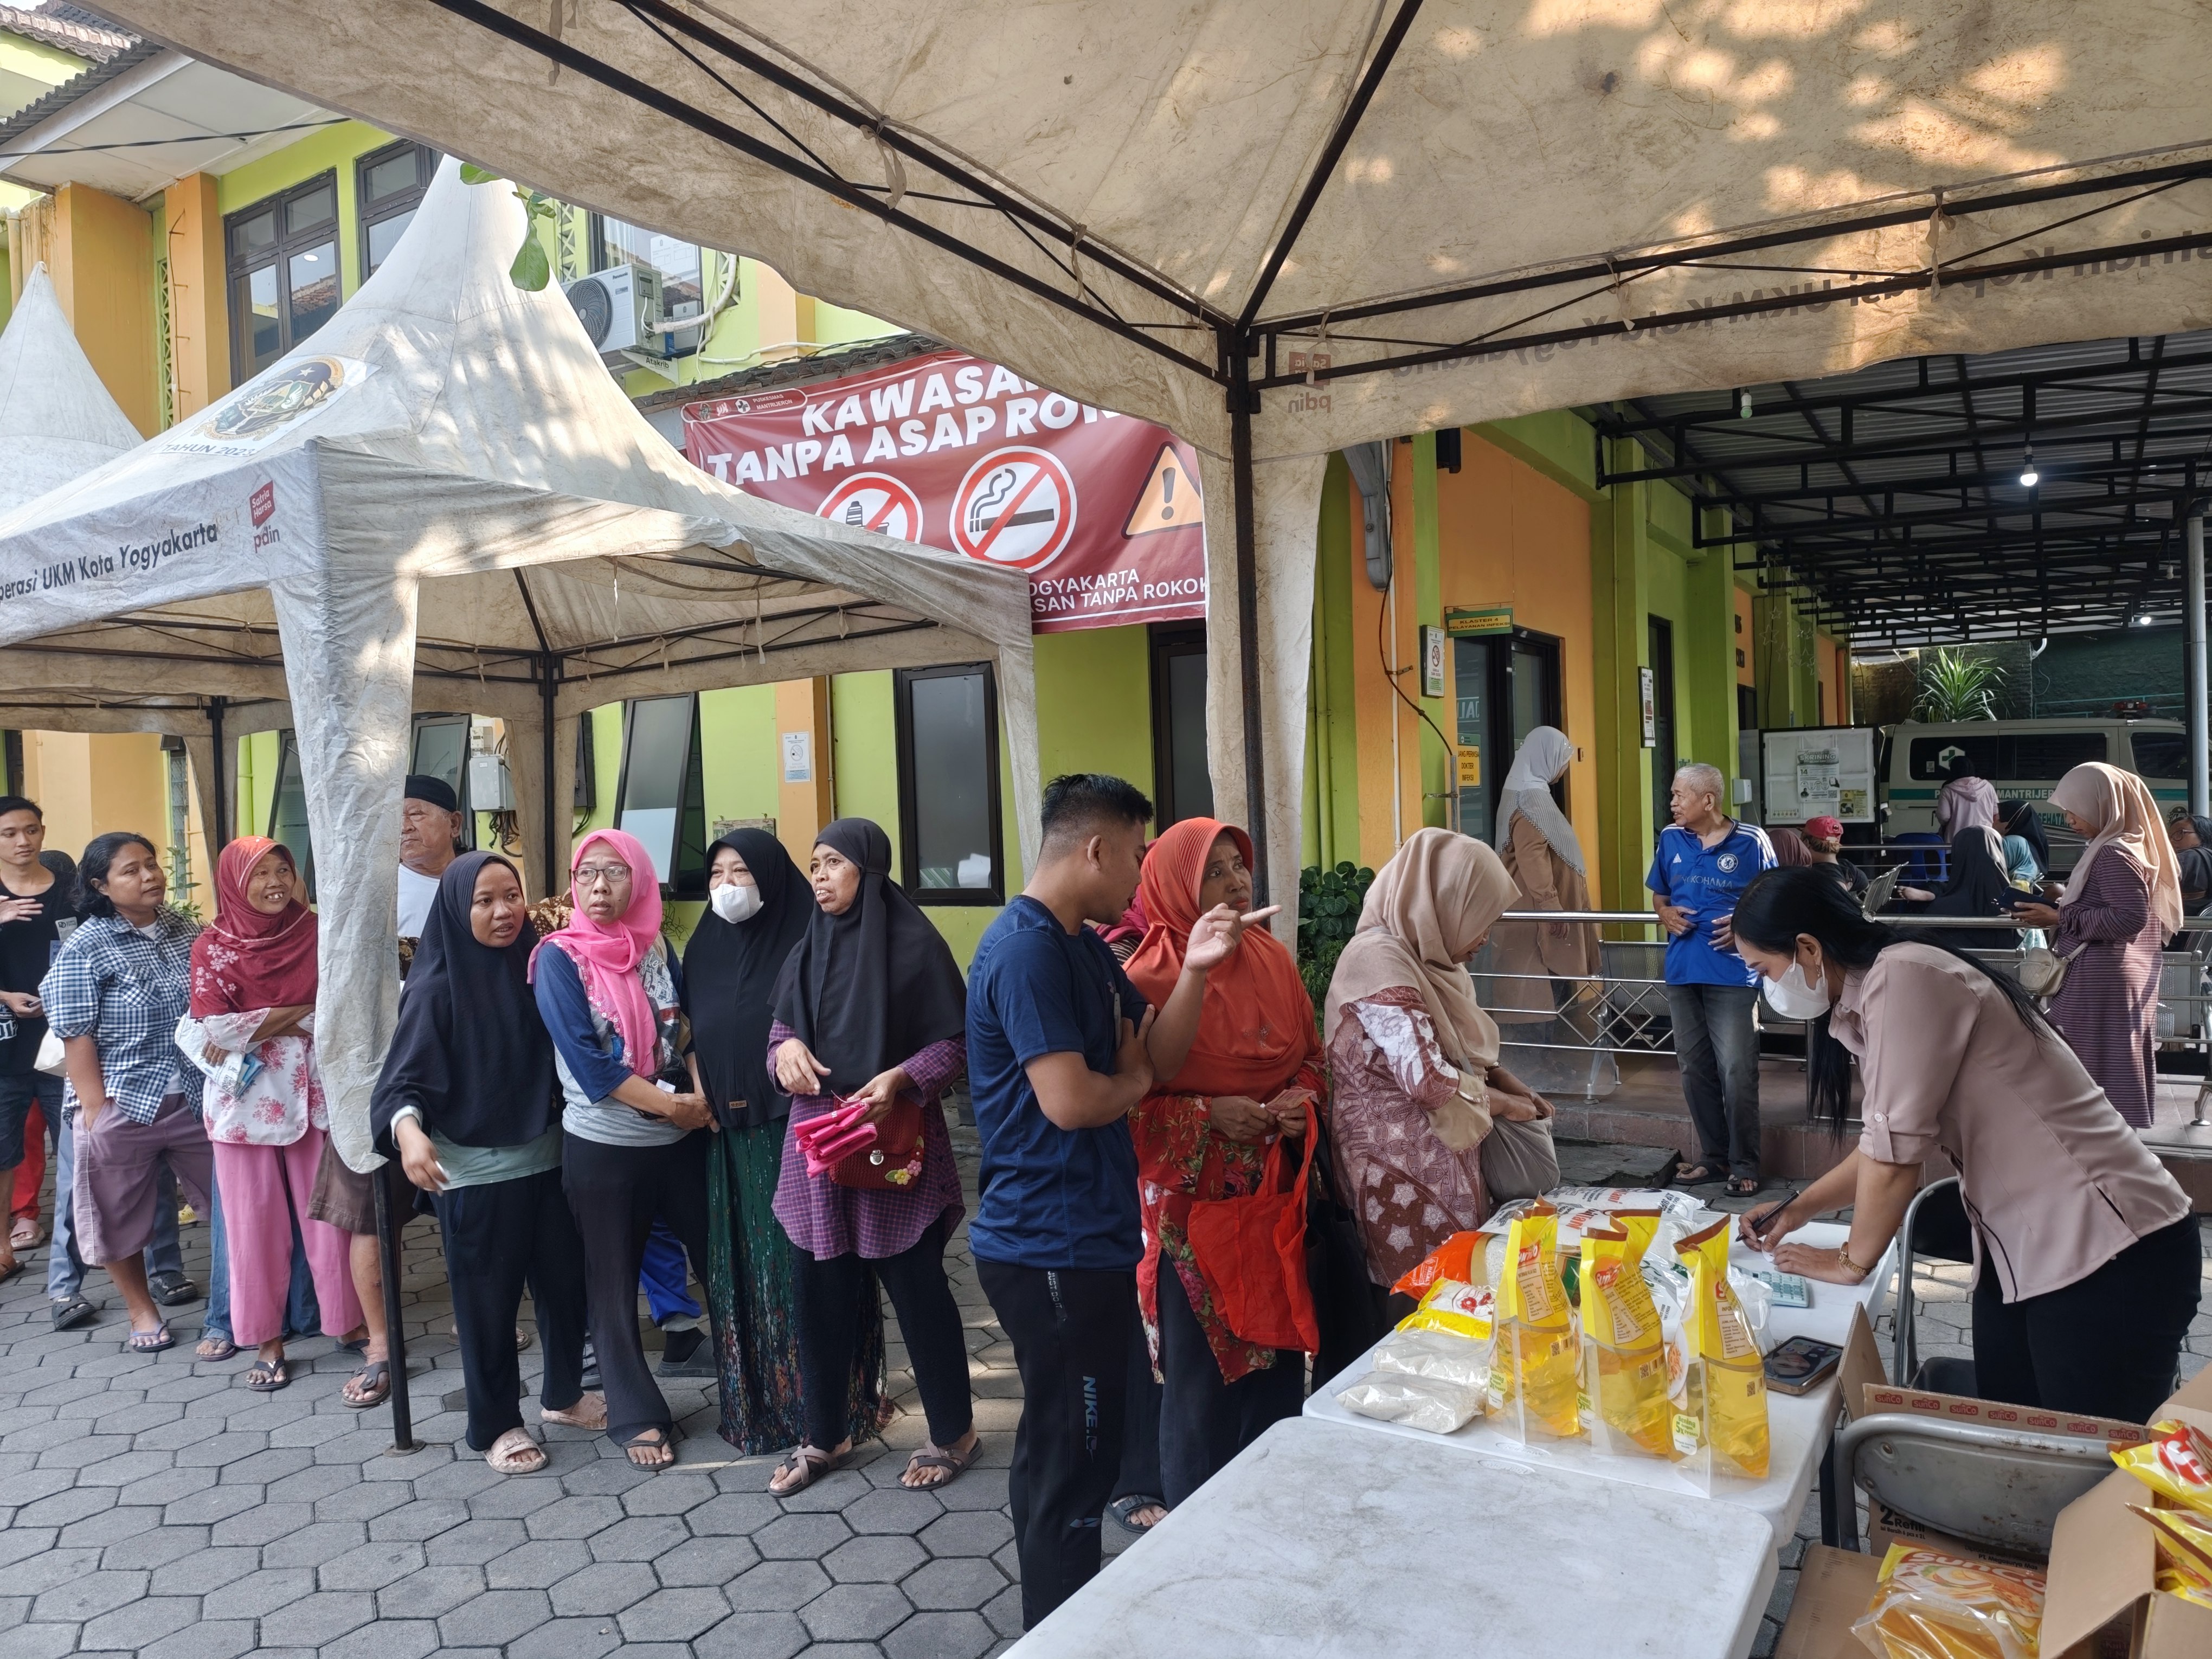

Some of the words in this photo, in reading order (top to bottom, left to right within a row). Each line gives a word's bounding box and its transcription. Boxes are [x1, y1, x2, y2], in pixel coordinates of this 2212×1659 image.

[646, 357, 669, 369] Atakrib
[752, 394, 784, 403] PUSKESMAS
[756, 400, 793, 410] MANTRIJERON
[163, 443, 217, 453] TAHUN
[219, 447, 256, 456] 2023
[707, 434, 854, 485] TANPA
[863, 406, 996, 464] ASAP
[252, 489, 270, 508] Satria
[254, 500, 272, 519] Harsa
[253, 525, 280, 554] pdin
[43, 561, 75, 589] UKM
[78, 556, 114, 580] Kota
[119, 523, 217, 570] Yogyakarta
[1030, 569, 1140, 596] OGYAKARTA
[1081, 586, 1138, 607] TANPA
[1682, 876, 1733, 889] YOKOHAMA
[1047, 1271, 1057, 1290] JUST
[1051, 1291, 1059, 1302] DO
[1877, 1395, 1901, 1404] SunCo
[1914, 1400, 1939, 1409] SunCo
[1951, 1405, 1977, 1414] SunCo
[1990, 1411, 2016, 1420] SunCo
[1679, 1416, 1696, 1428] Bening
[2029, 1417, 2055, 1426] SunCo
[2068, 1423, 2097, 1433] SunCo
[2110, 1429, 2138, 1439] SunCo
[1894, 1517, 1925, 1533] Refill
[1988, 1555, 2023, 1567] Megasurya
[1908, 1552, 2047, 1593] SunCo
